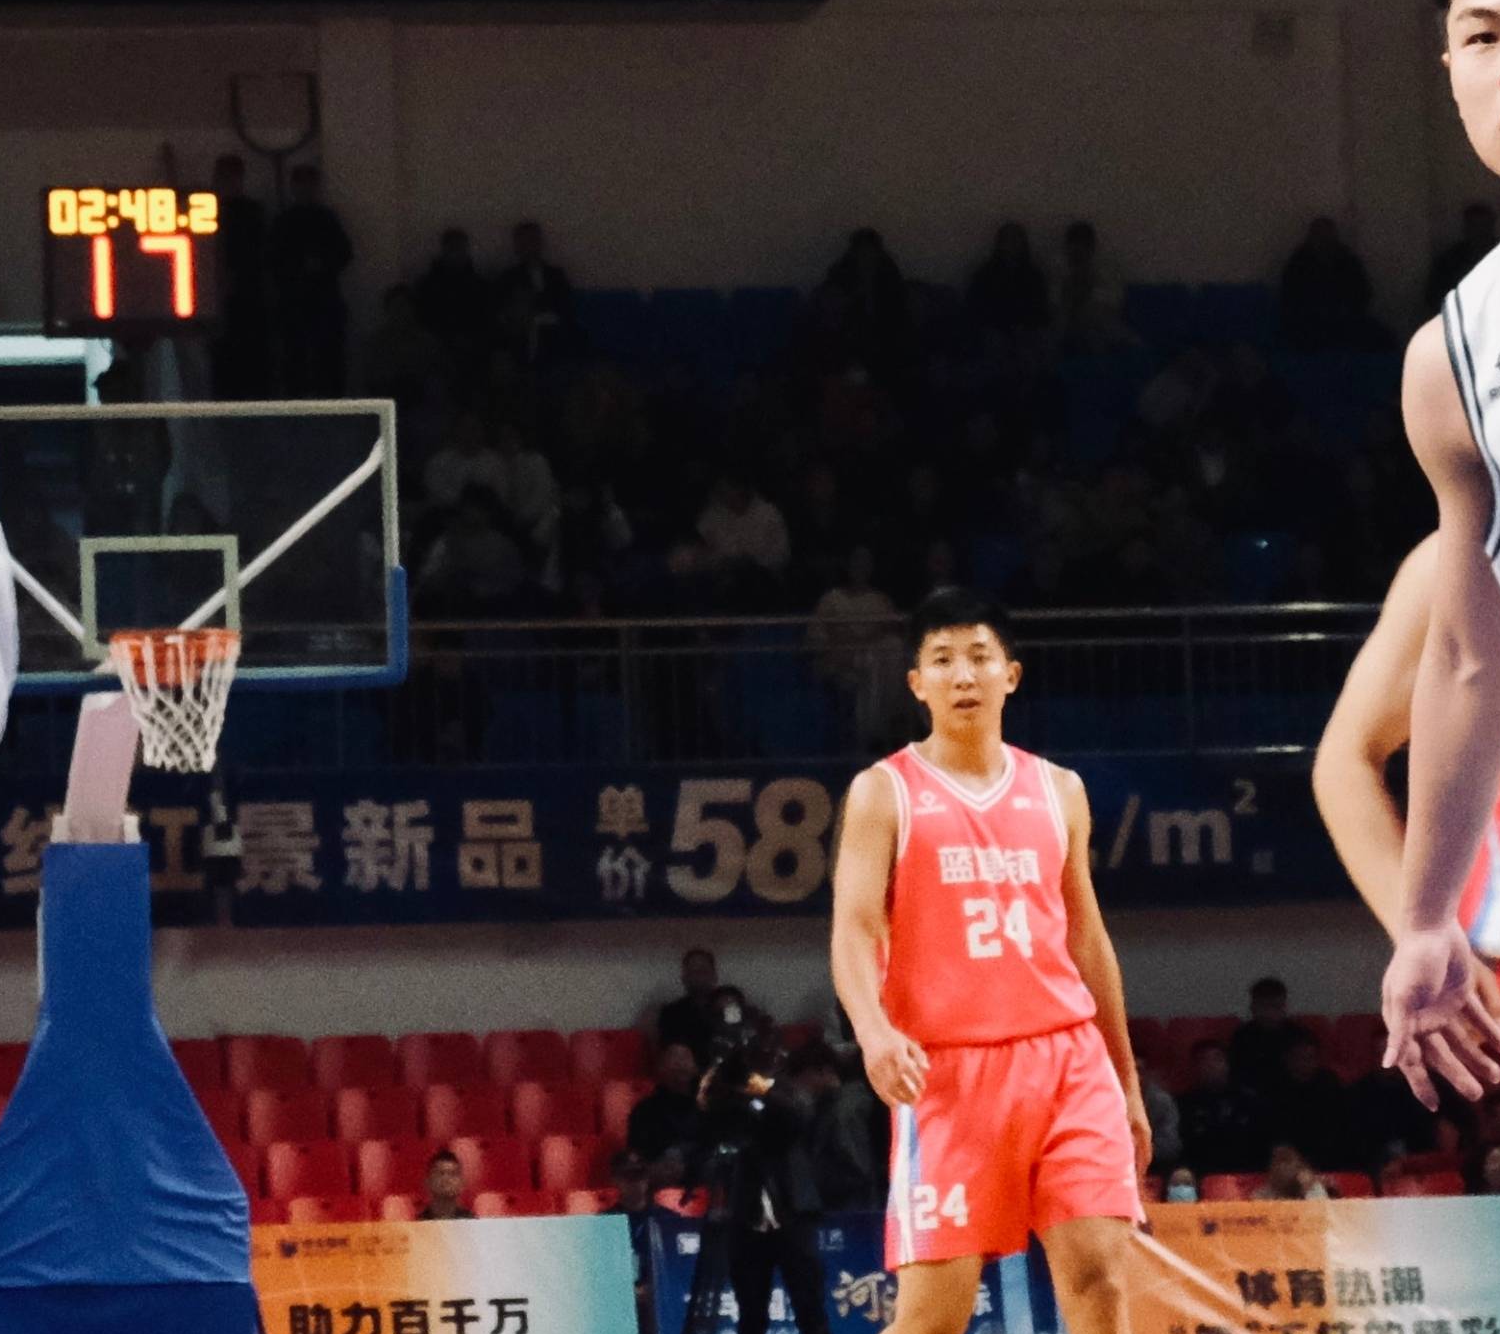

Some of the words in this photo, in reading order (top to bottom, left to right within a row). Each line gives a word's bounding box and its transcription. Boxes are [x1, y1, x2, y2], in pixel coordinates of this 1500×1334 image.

[48, 187, 219, 234] 02:48.2
[89, 233, 196, 320] 17
[963, 898, 1033, 959] 24
[912, 1183, 968, 1231] 24
[1237, 1267, 1424, 1308] 体育热潮
